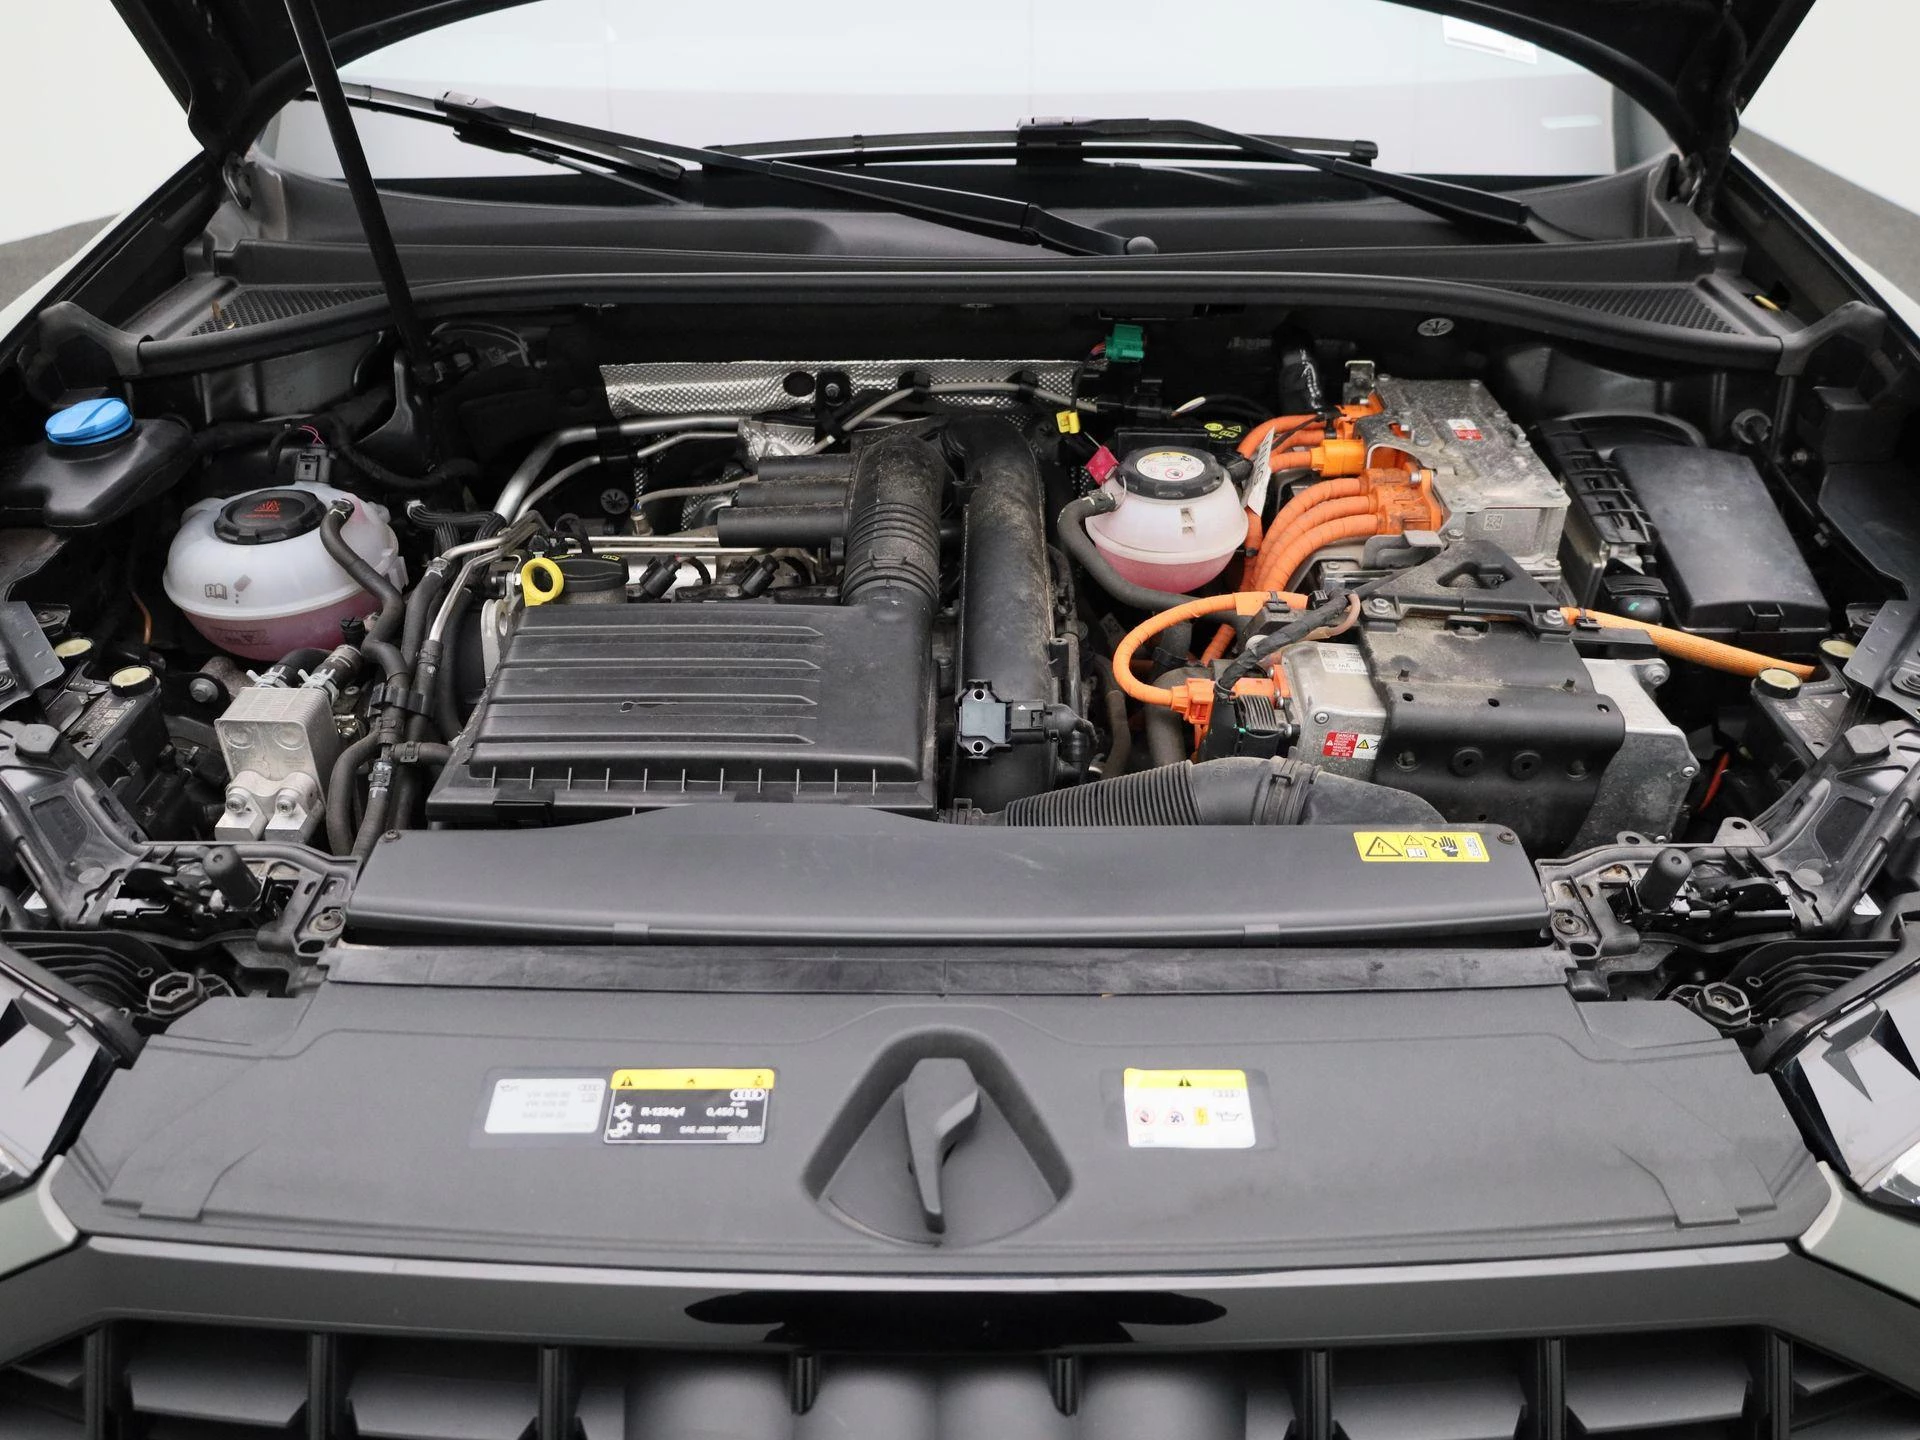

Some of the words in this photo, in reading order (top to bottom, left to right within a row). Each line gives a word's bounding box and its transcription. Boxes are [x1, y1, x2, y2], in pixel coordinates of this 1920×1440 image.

[640, 1107, 687, 1118] R-1234yf
[735, 1107, 749, 1118] kg
[637, 1124, 661, 1134] PAG
